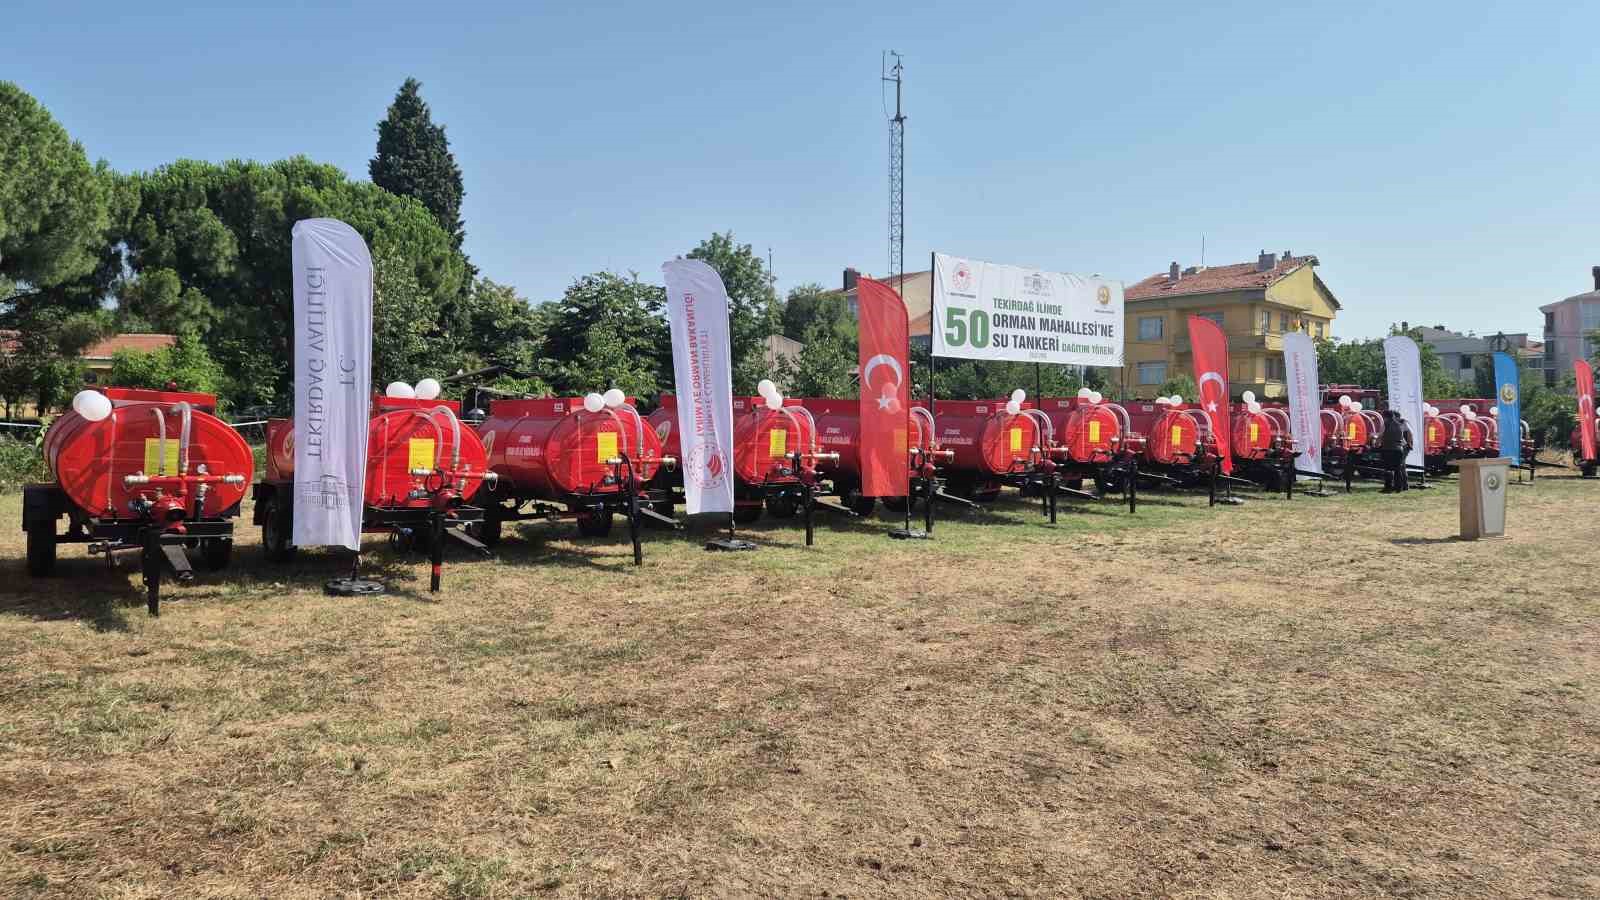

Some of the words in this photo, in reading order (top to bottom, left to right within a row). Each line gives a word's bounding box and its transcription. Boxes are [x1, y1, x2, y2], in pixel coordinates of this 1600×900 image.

[945, 307, 989, 348] 50
[993, 314, 1036, 331] ORMAN
[1039, 318, 1114, 337] MAHALLESİ'NE
[993, 334, 1009, 348] SU
[1013, 335, 1059, 352] TANKERİ
